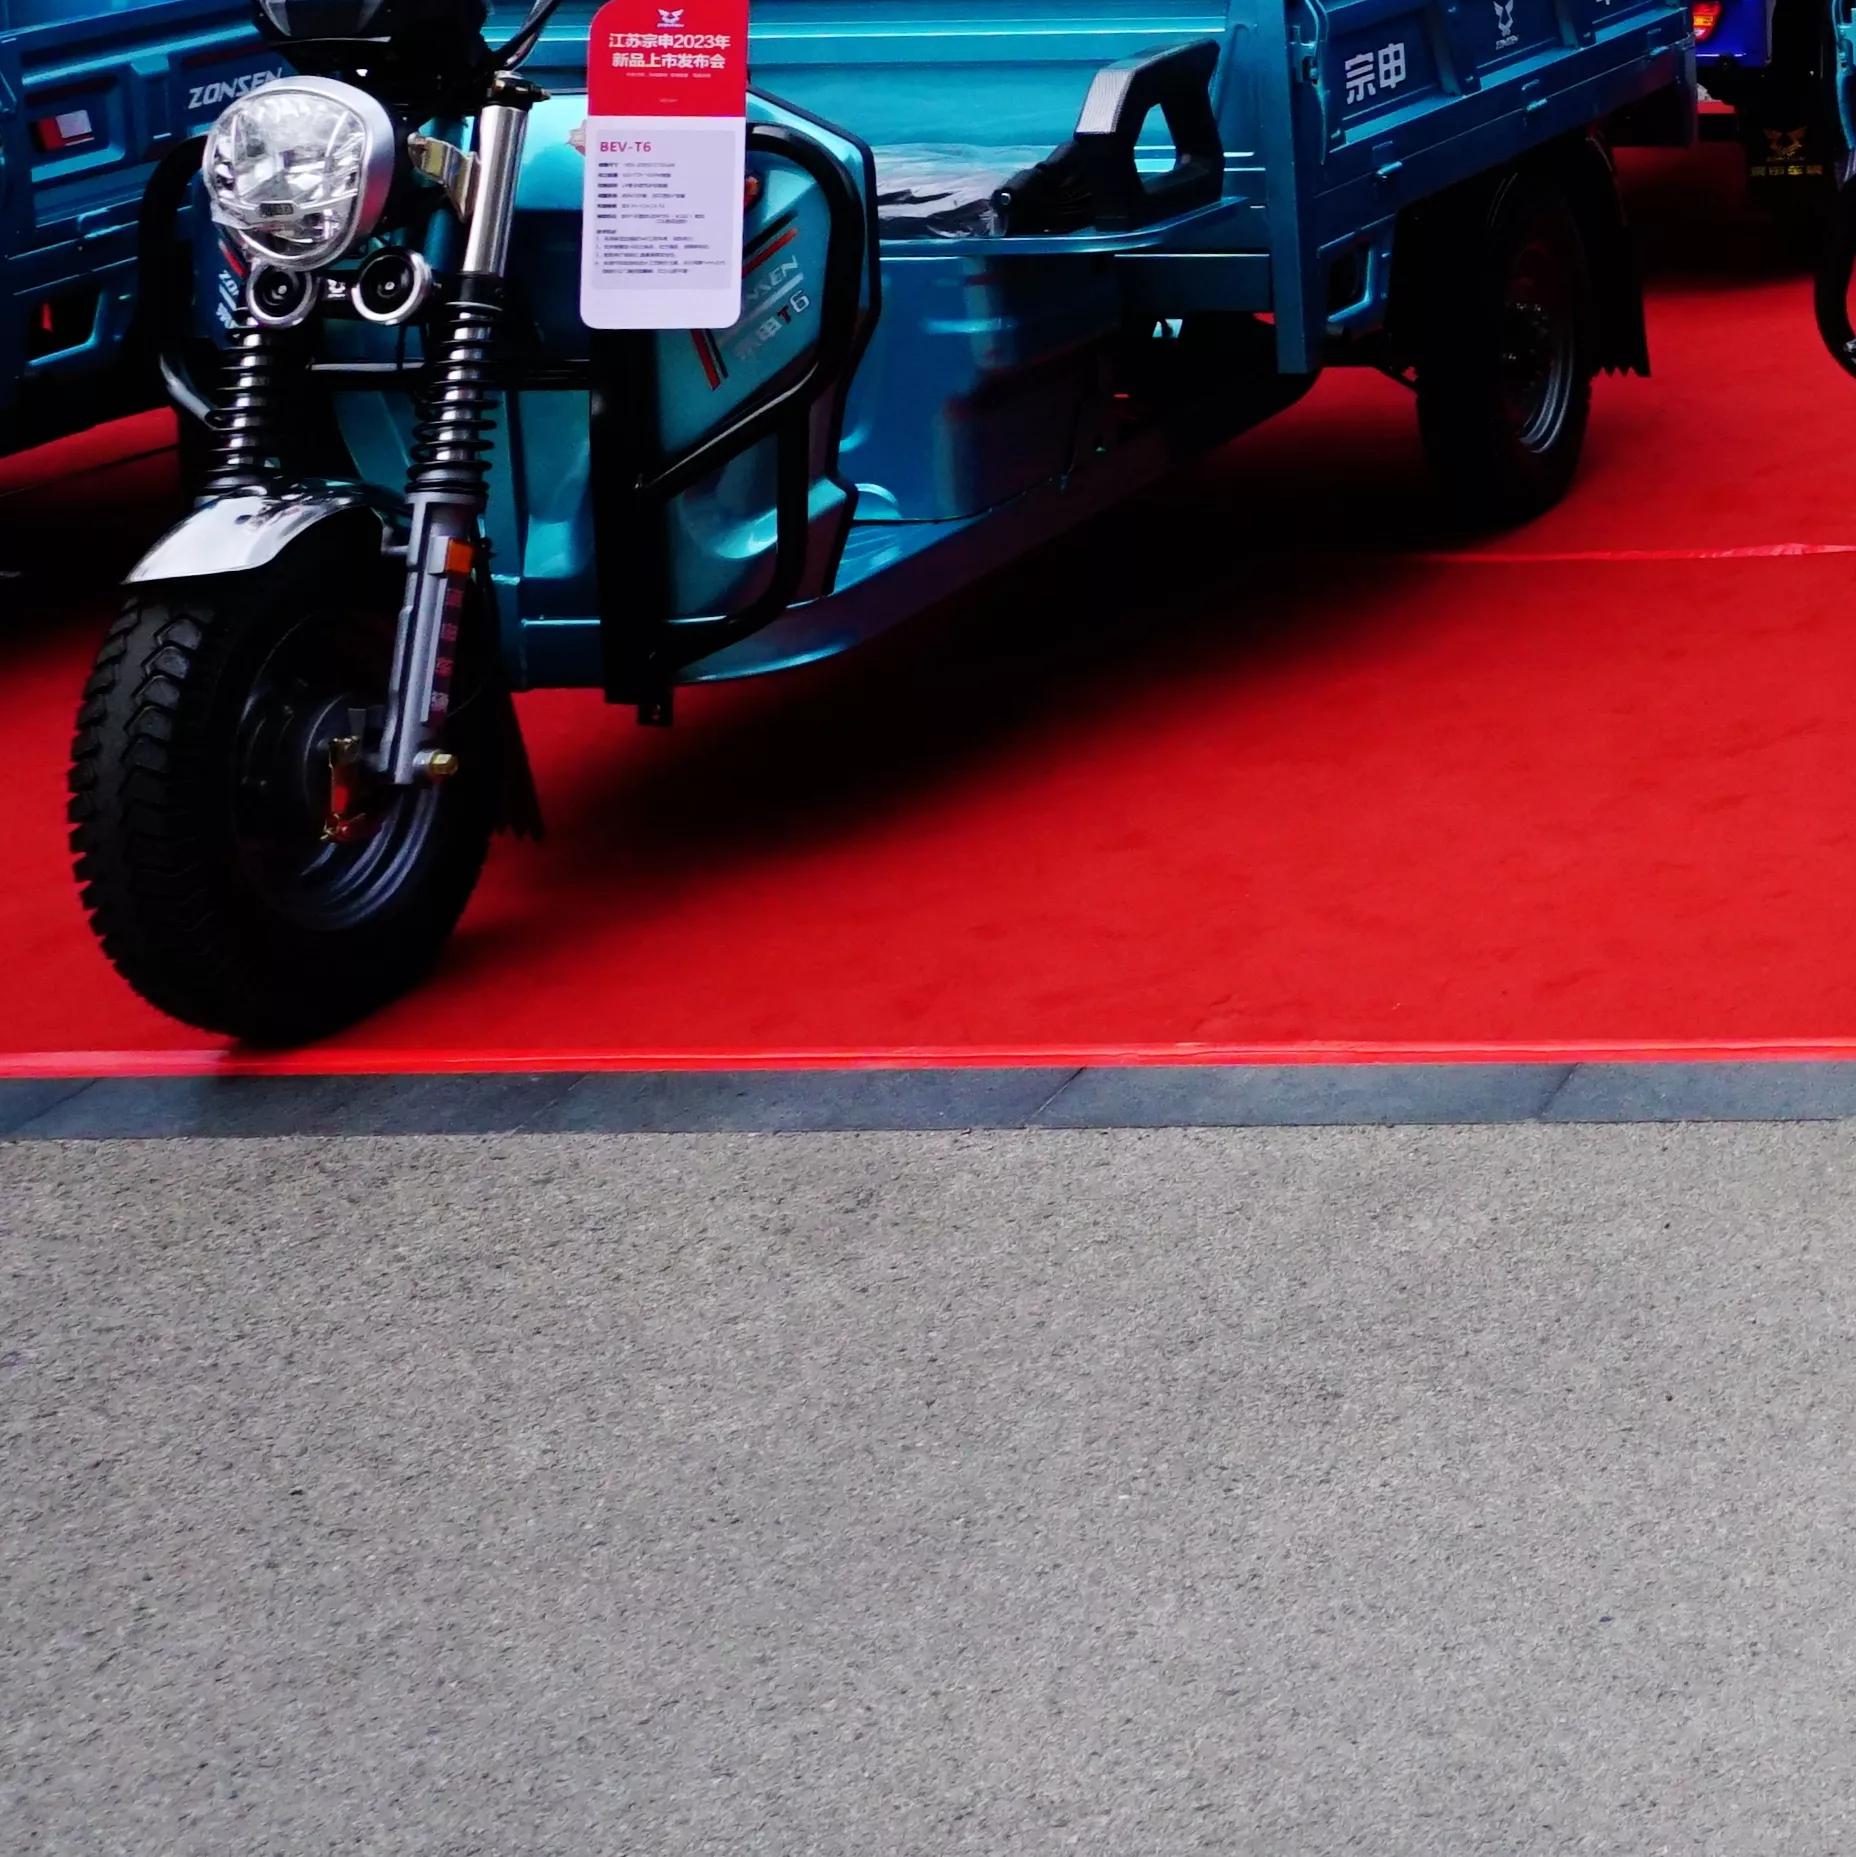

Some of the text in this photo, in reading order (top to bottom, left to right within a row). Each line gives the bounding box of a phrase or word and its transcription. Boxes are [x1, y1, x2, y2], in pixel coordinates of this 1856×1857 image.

[608, 32, 732, 50] 江苏宗申2023年
[612, 52, 727, 69] 新品上市发布会
[1344, 41, 1406, 105] 宗申
[600, 141, 652, 153] BEV-T6
